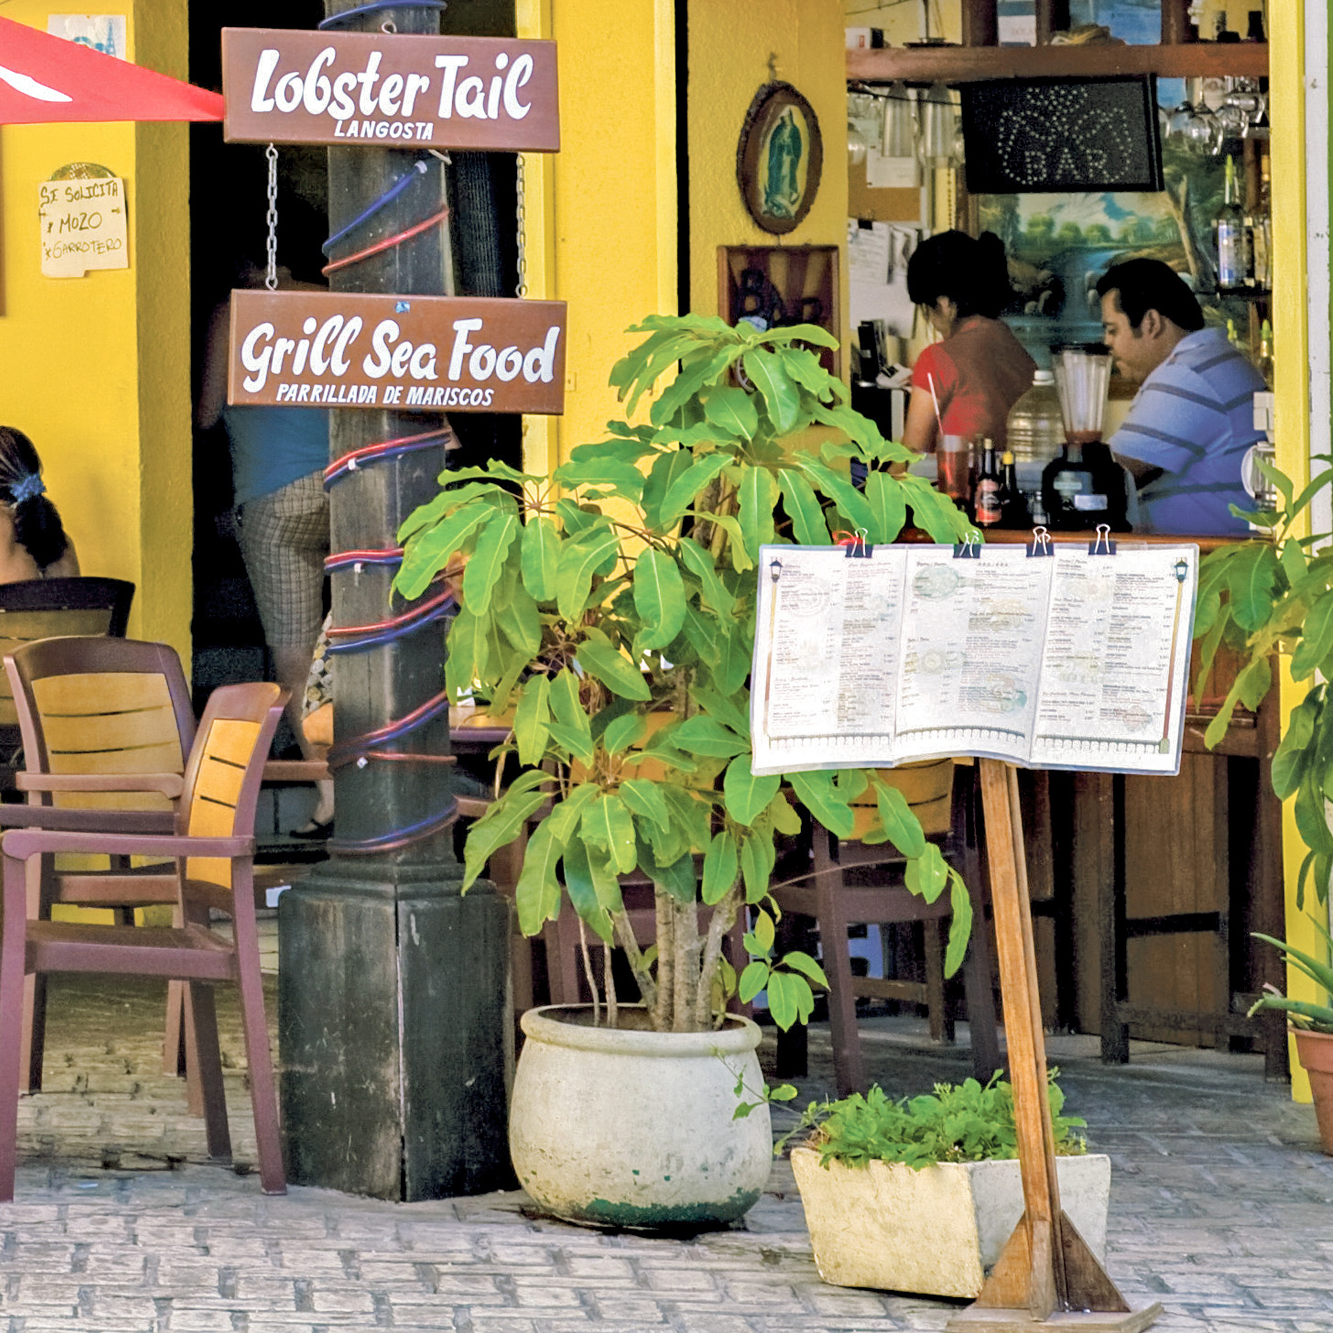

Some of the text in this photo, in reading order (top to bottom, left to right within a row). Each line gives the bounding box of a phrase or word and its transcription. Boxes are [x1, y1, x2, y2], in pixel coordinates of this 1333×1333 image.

[250, 46, 534, 121] Lobster Tail
[333, 120, 434, 141] LANGOSTA
[1024, 148, 1109, 186] BAR
[58, 212, 103, 234] MOZO
[240, 314, 561, 393] Grill Sea Food
[275, 382, 495, 407] PARRILLADA DE MARISCOS
